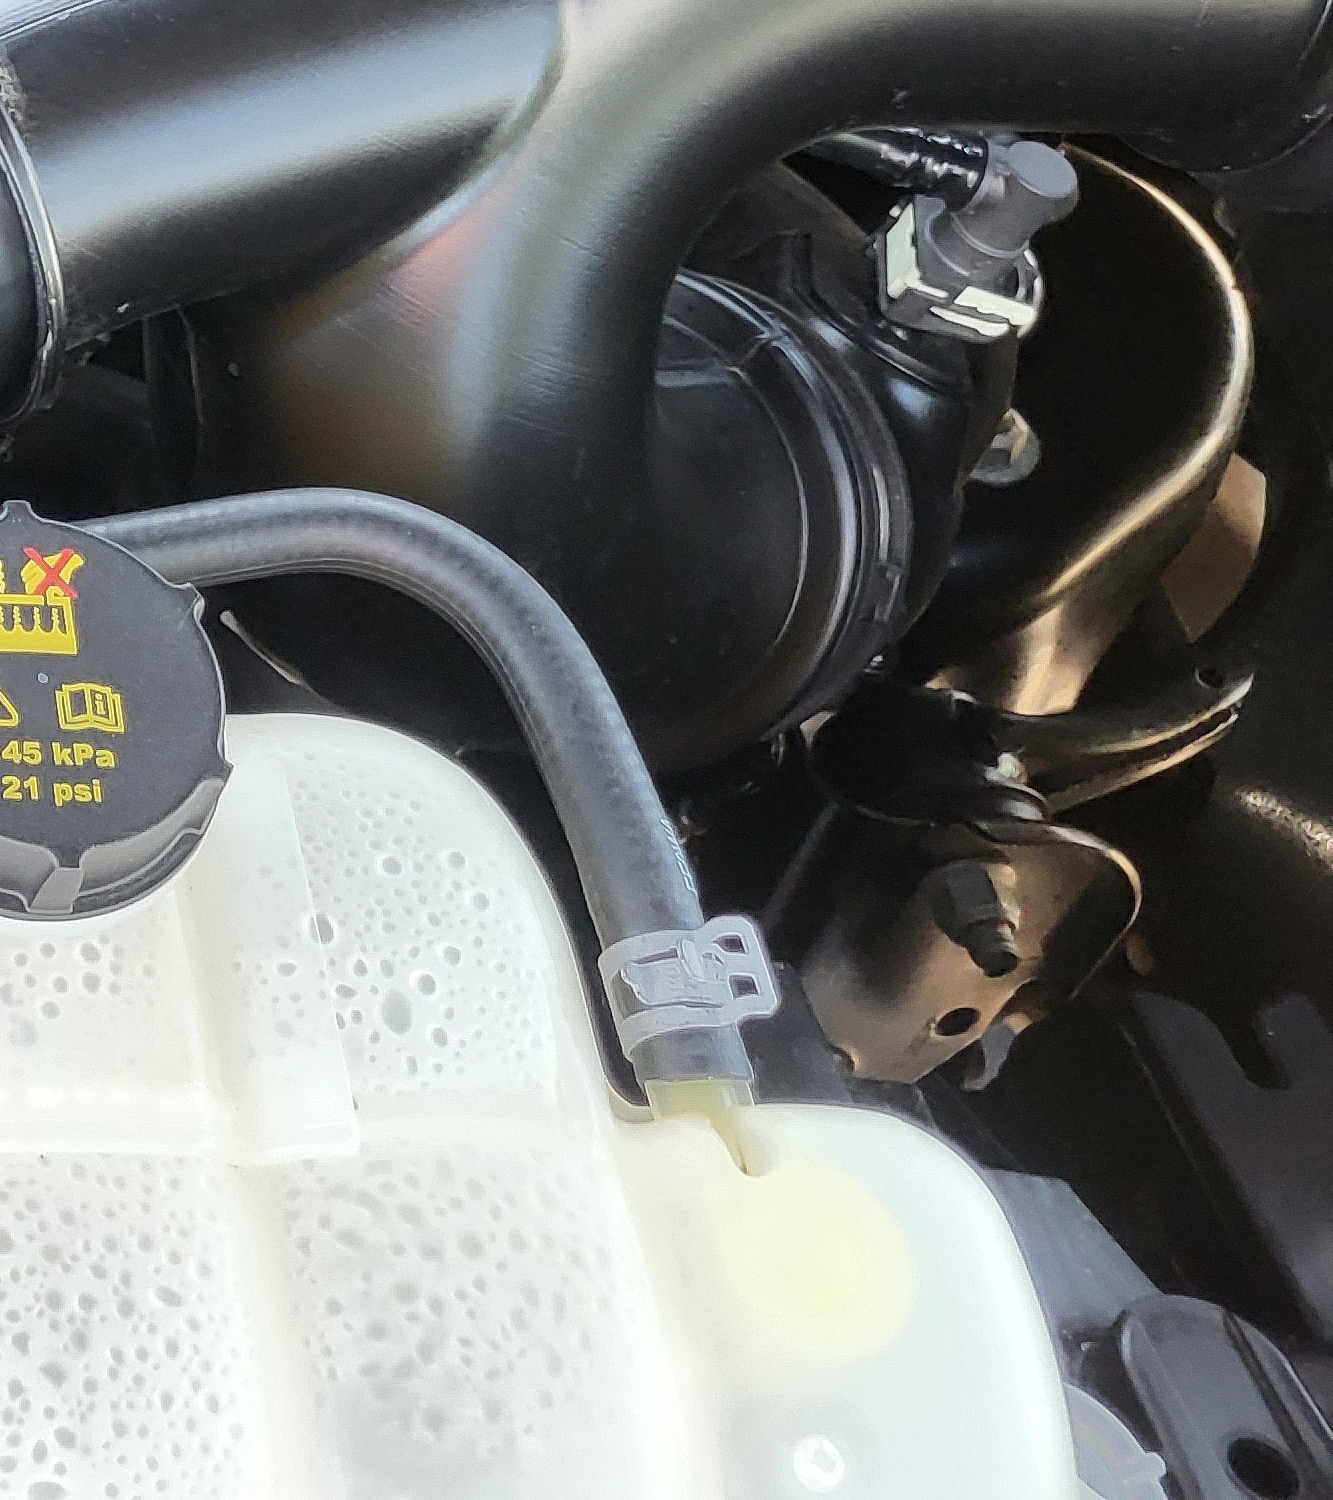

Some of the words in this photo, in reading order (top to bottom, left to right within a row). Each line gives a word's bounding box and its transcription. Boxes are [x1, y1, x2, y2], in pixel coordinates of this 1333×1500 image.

[53, 741, 117, 769] kPa
[1, 775, 40, 801] 21
[53, 778, 104, 807] psi
